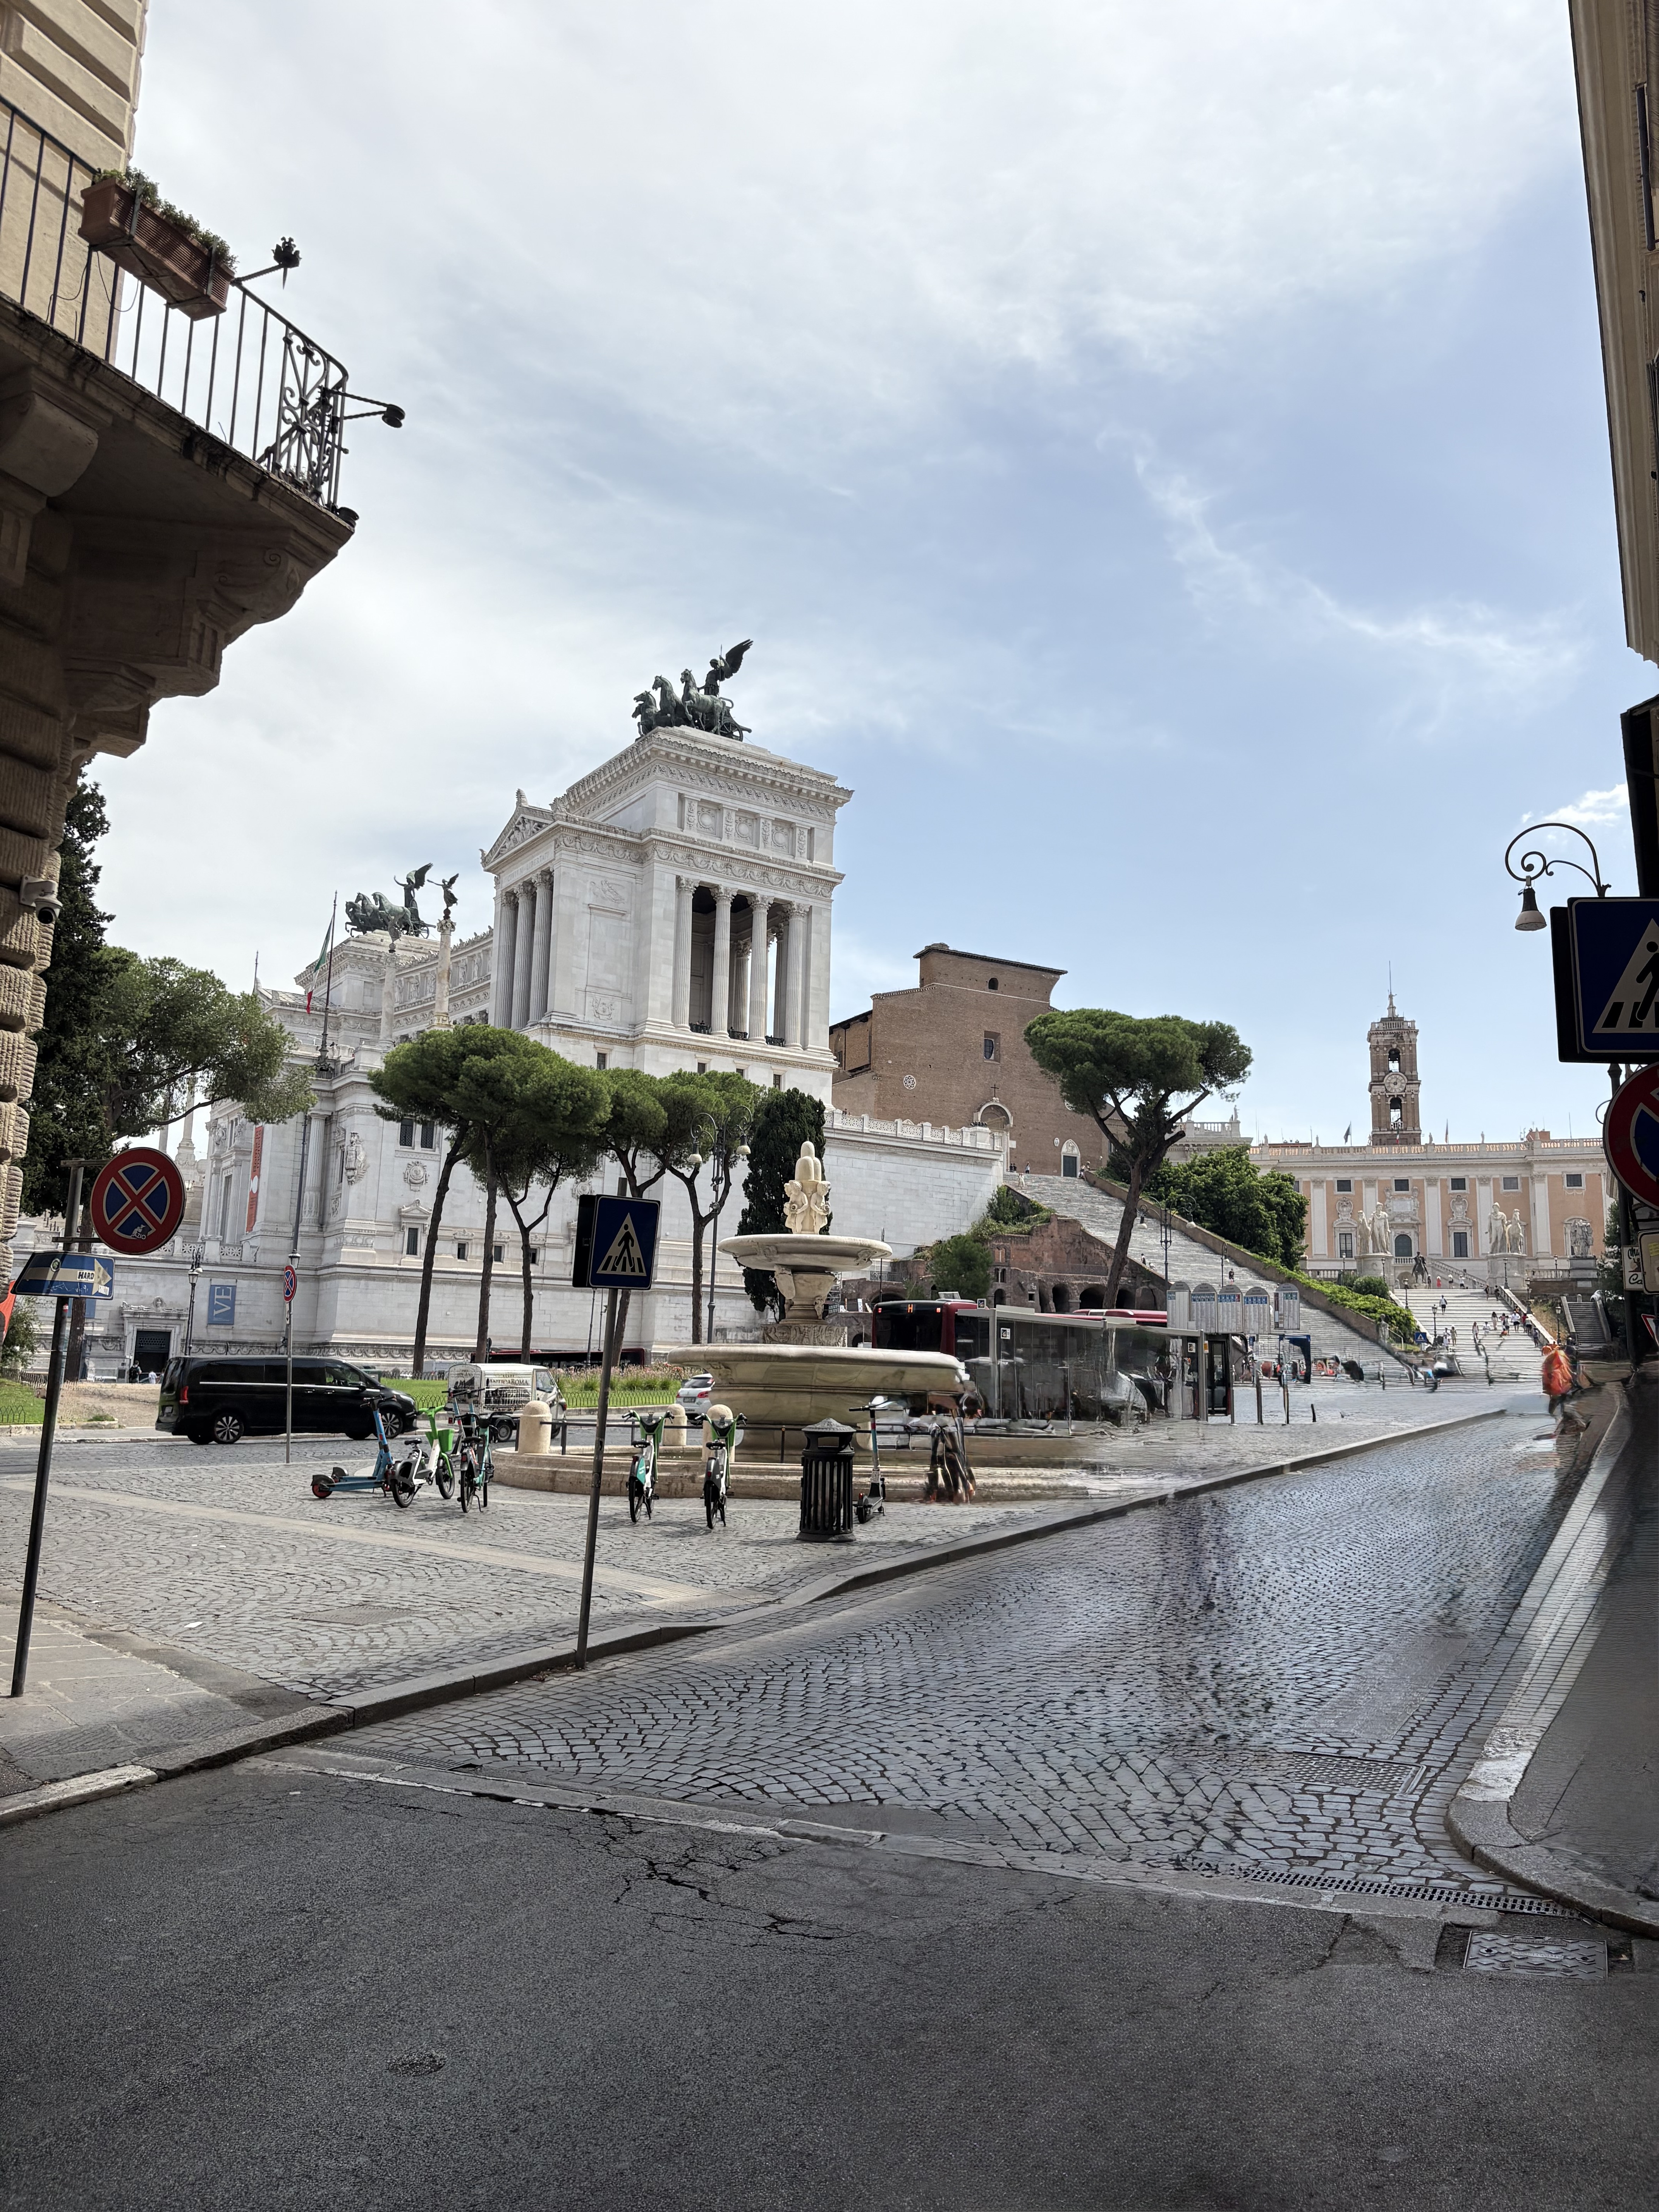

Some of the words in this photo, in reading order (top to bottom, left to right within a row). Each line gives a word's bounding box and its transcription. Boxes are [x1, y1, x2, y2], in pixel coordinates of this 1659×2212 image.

[78, 1271, 94, 1280] HARD
[1629, 1273, 1643, 1285] Ca
[908, 1304, 913, 1313] H
